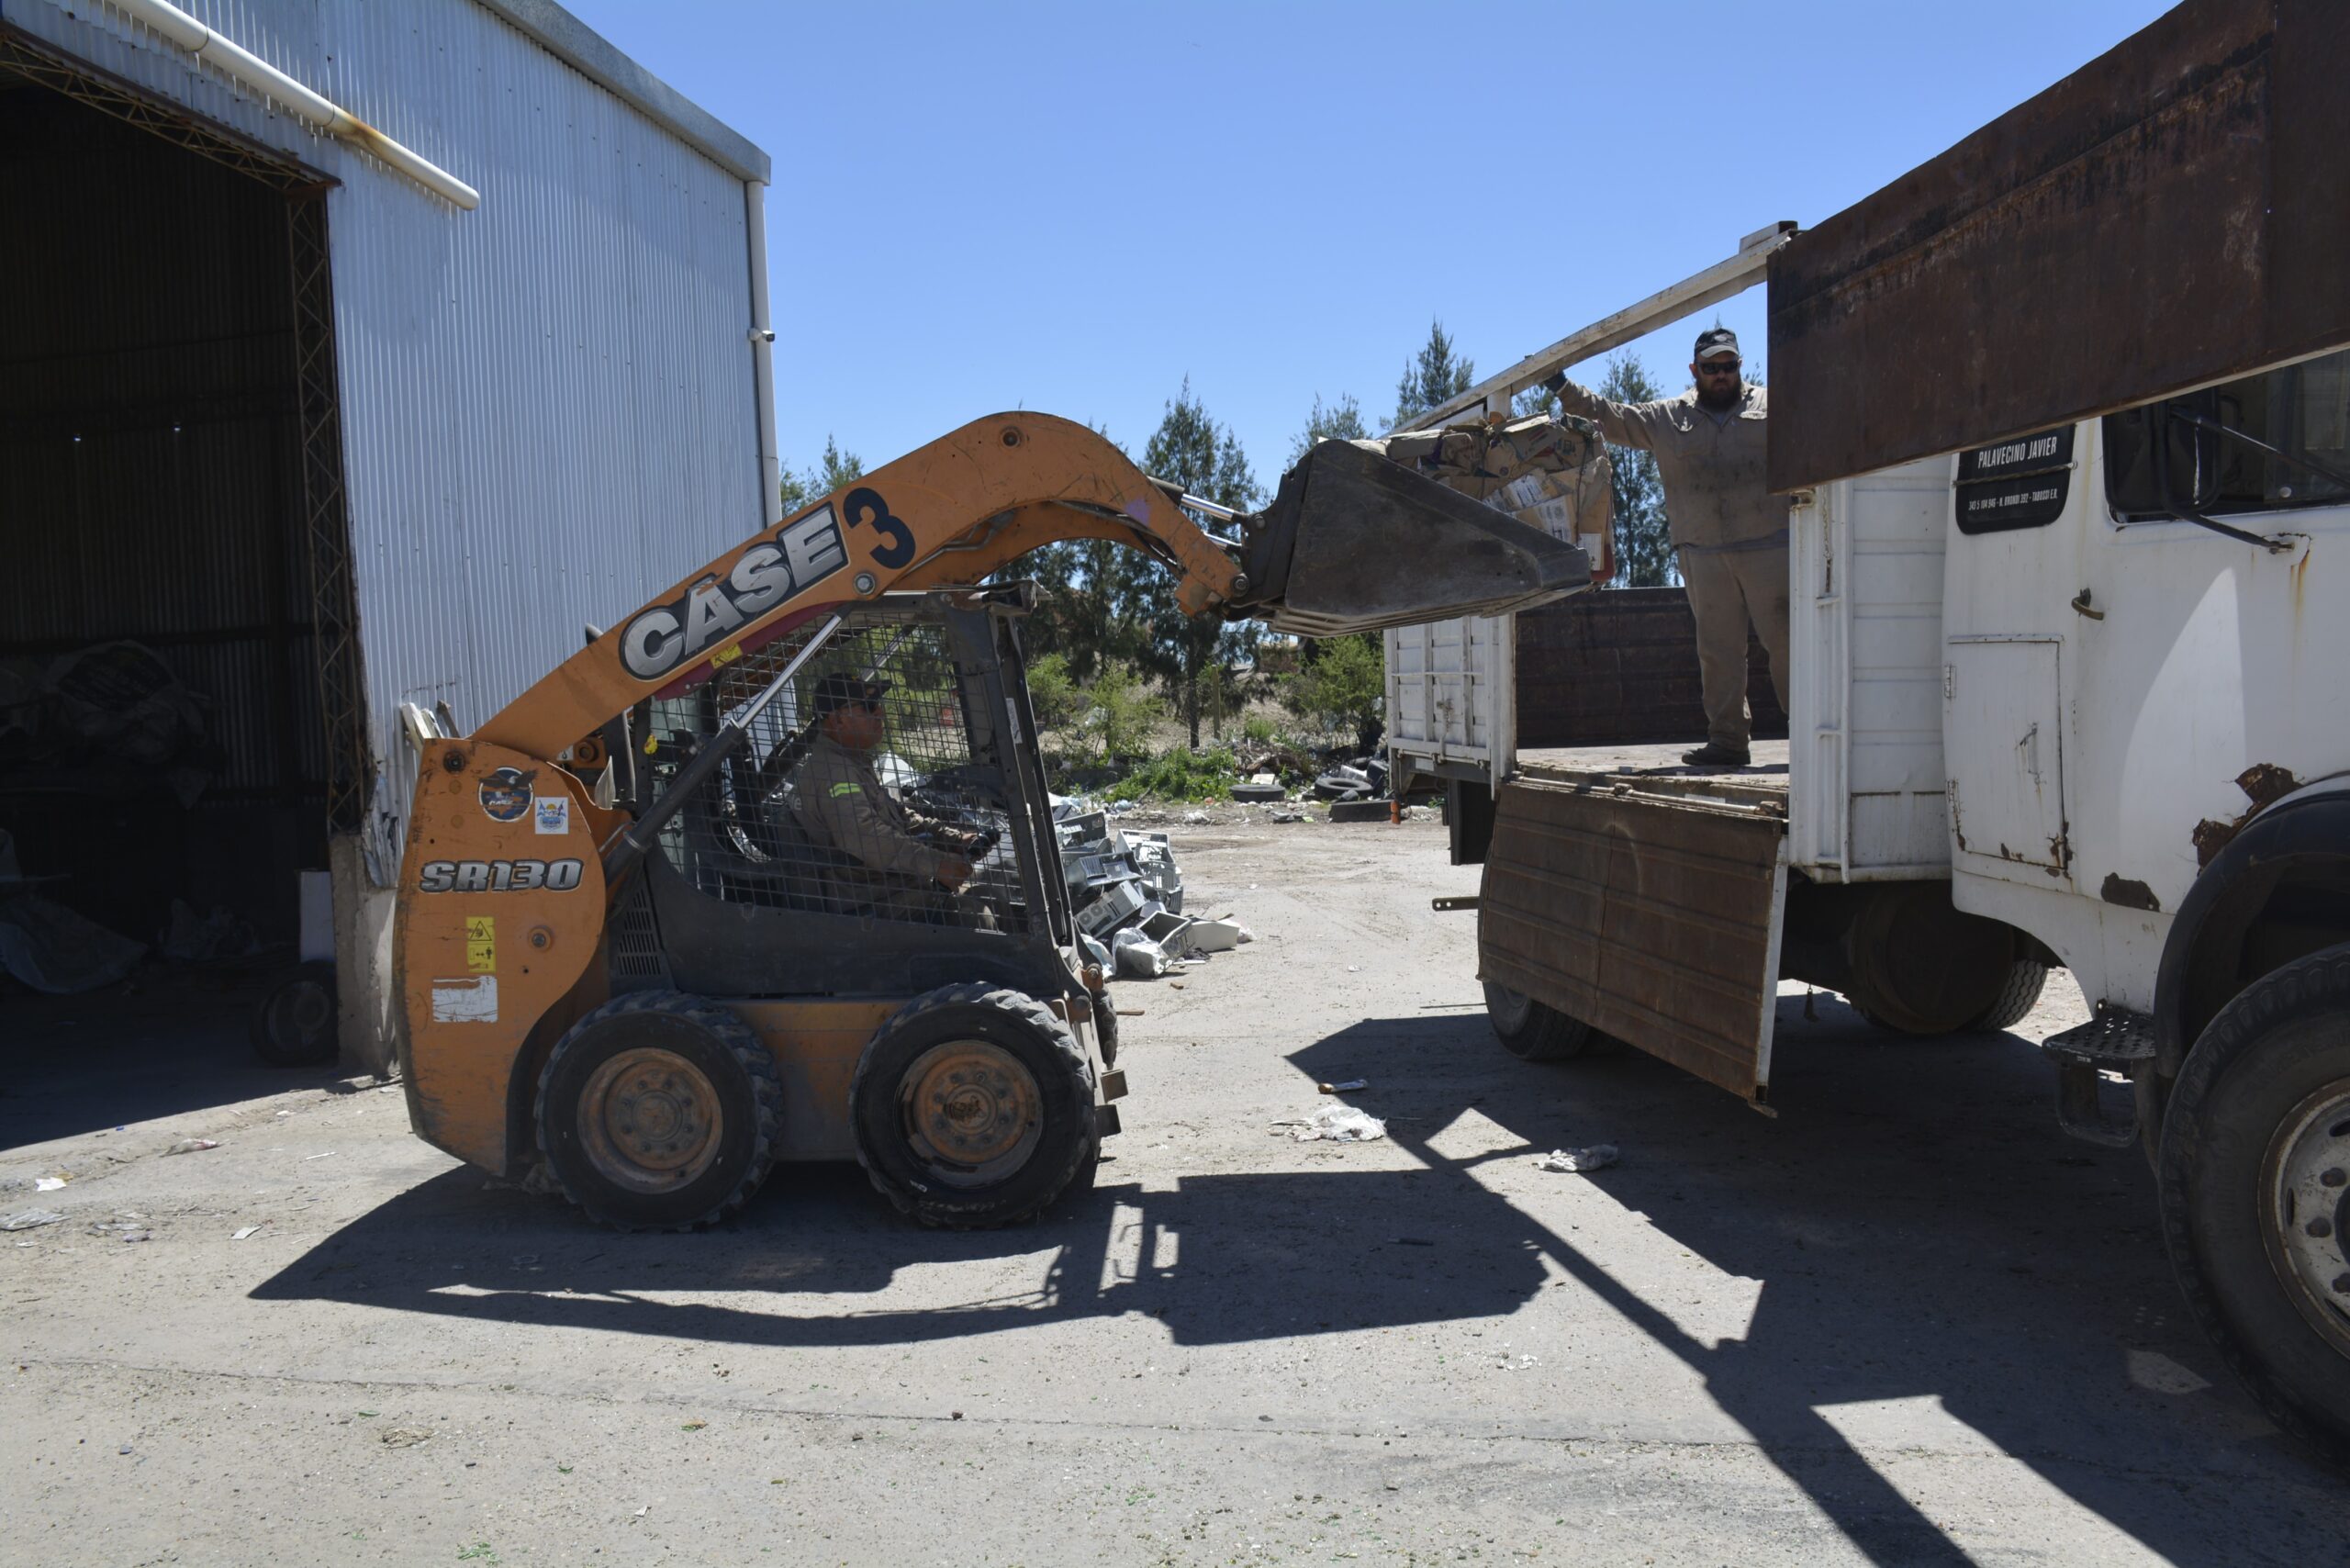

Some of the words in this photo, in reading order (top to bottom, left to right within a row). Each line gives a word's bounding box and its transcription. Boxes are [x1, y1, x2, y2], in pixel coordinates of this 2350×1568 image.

[1978, 442, 2026, 469] PALAVECINO
[2027, 436, 2058, 460] JAVIER
[843, 487, 916, 570] 3
[620, 502, 849, 680] CASE
[420, 858, 584, 893] SR130
